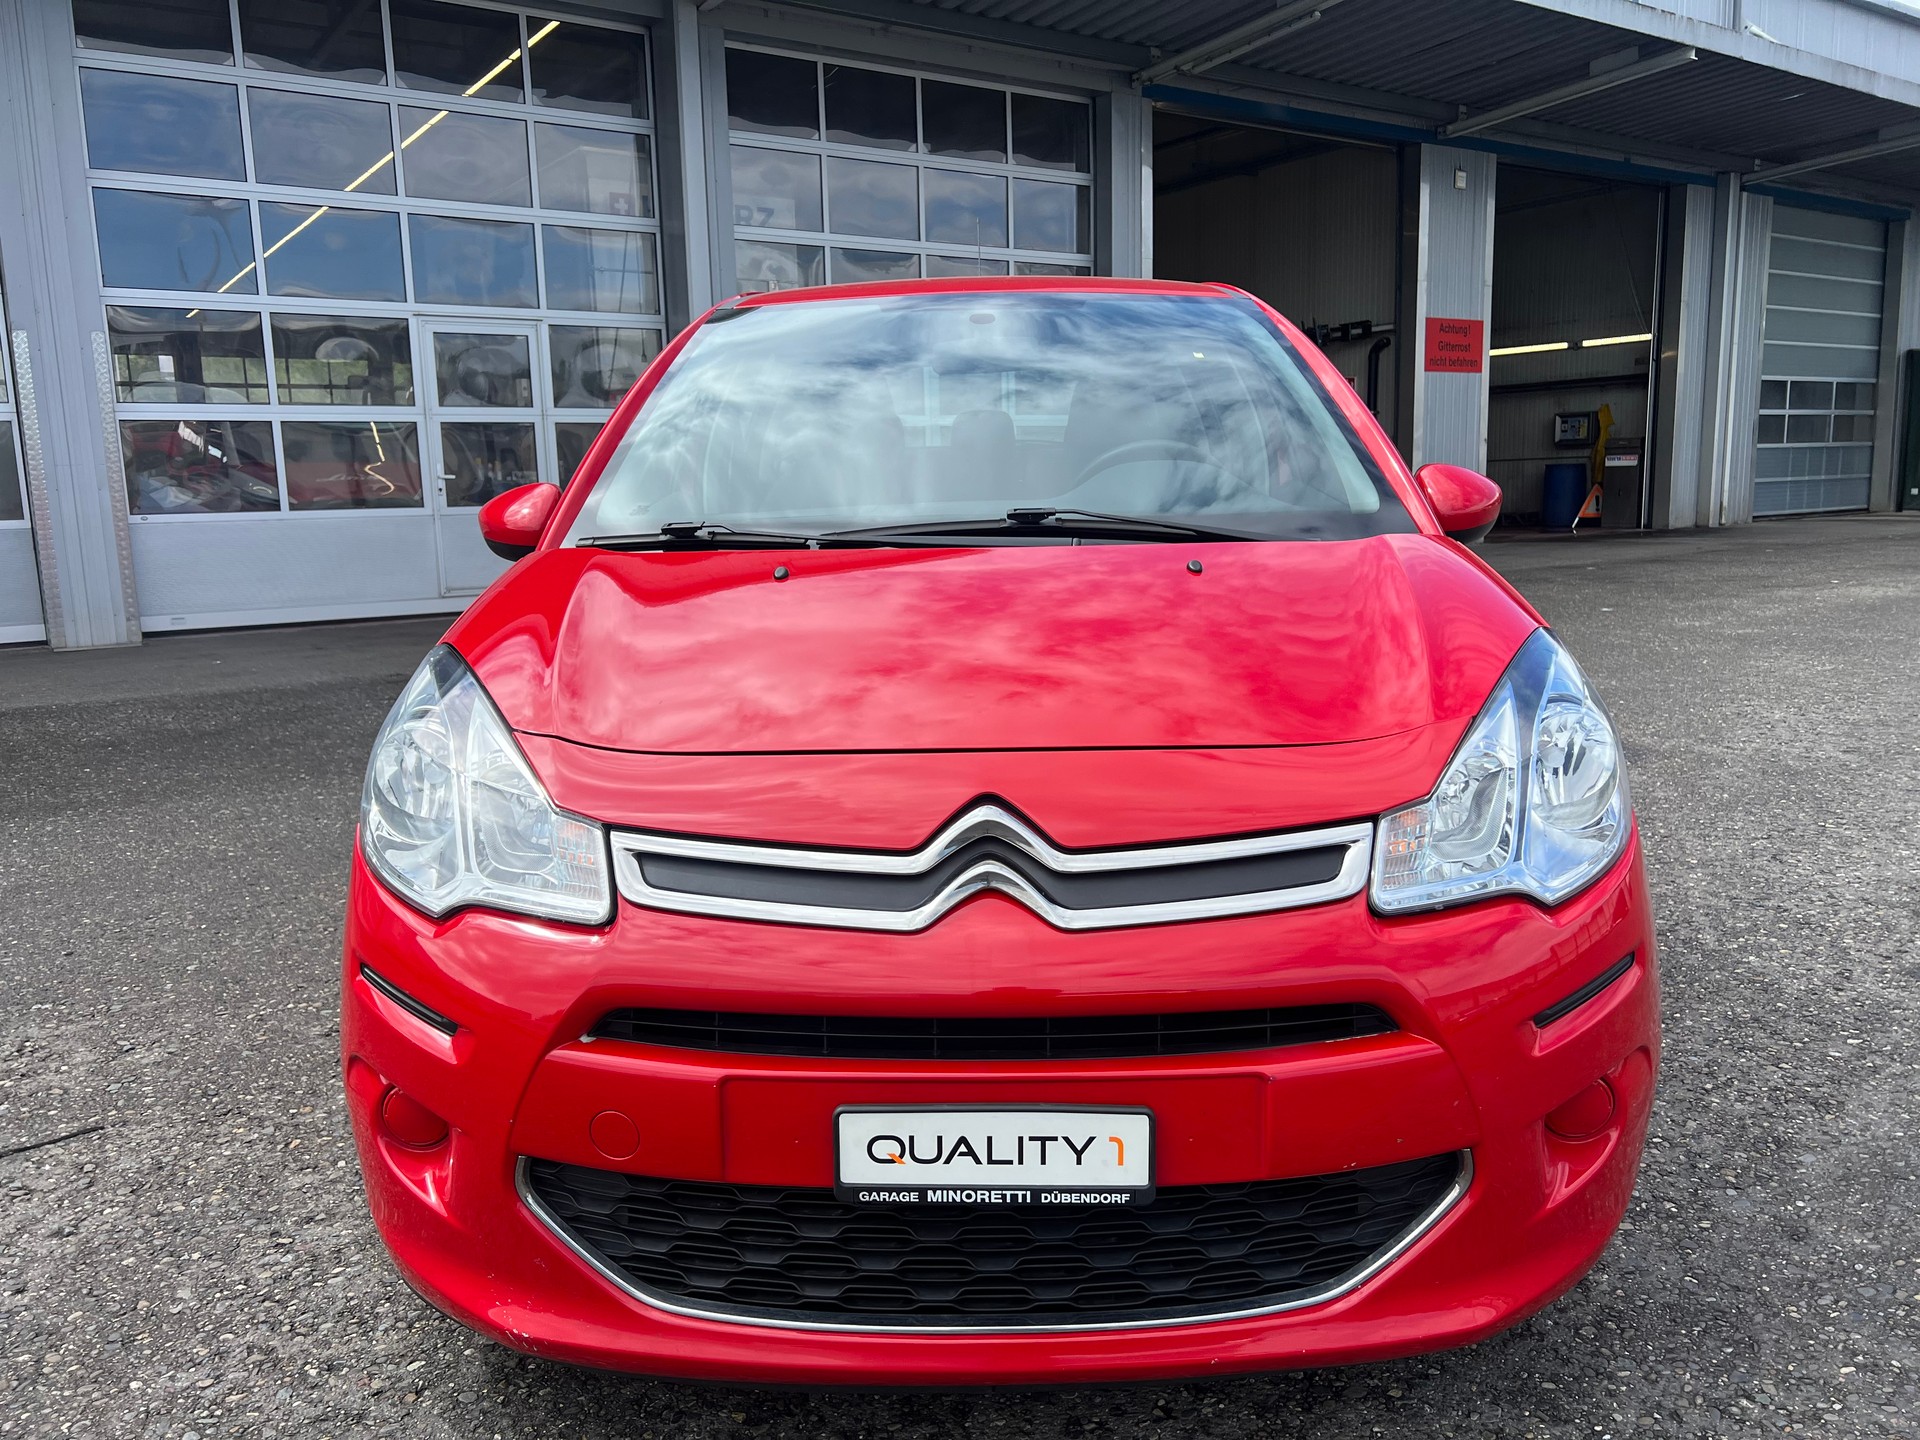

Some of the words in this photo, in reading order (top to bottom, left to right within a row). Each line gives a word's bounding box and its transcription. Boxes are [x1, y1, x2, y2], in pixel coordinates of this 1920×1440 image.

[1440, 323, 1471, 337] Achtung!
[1438, 341, 1471, 352] Gitterrost
[1429, 356, 1447, 367] nicht
[1448, 356, 1478, 368] befahren
[866, 1134, 1097, 1165] QUALITY
[1108, 1136, 1124, 1166] 1
[858, 1191, 919, 1202] GARAGE
[927, 1189, 1031, 1203] MINORETTI
[1041, 1190, 1131, 1204] DÜBENDORF
